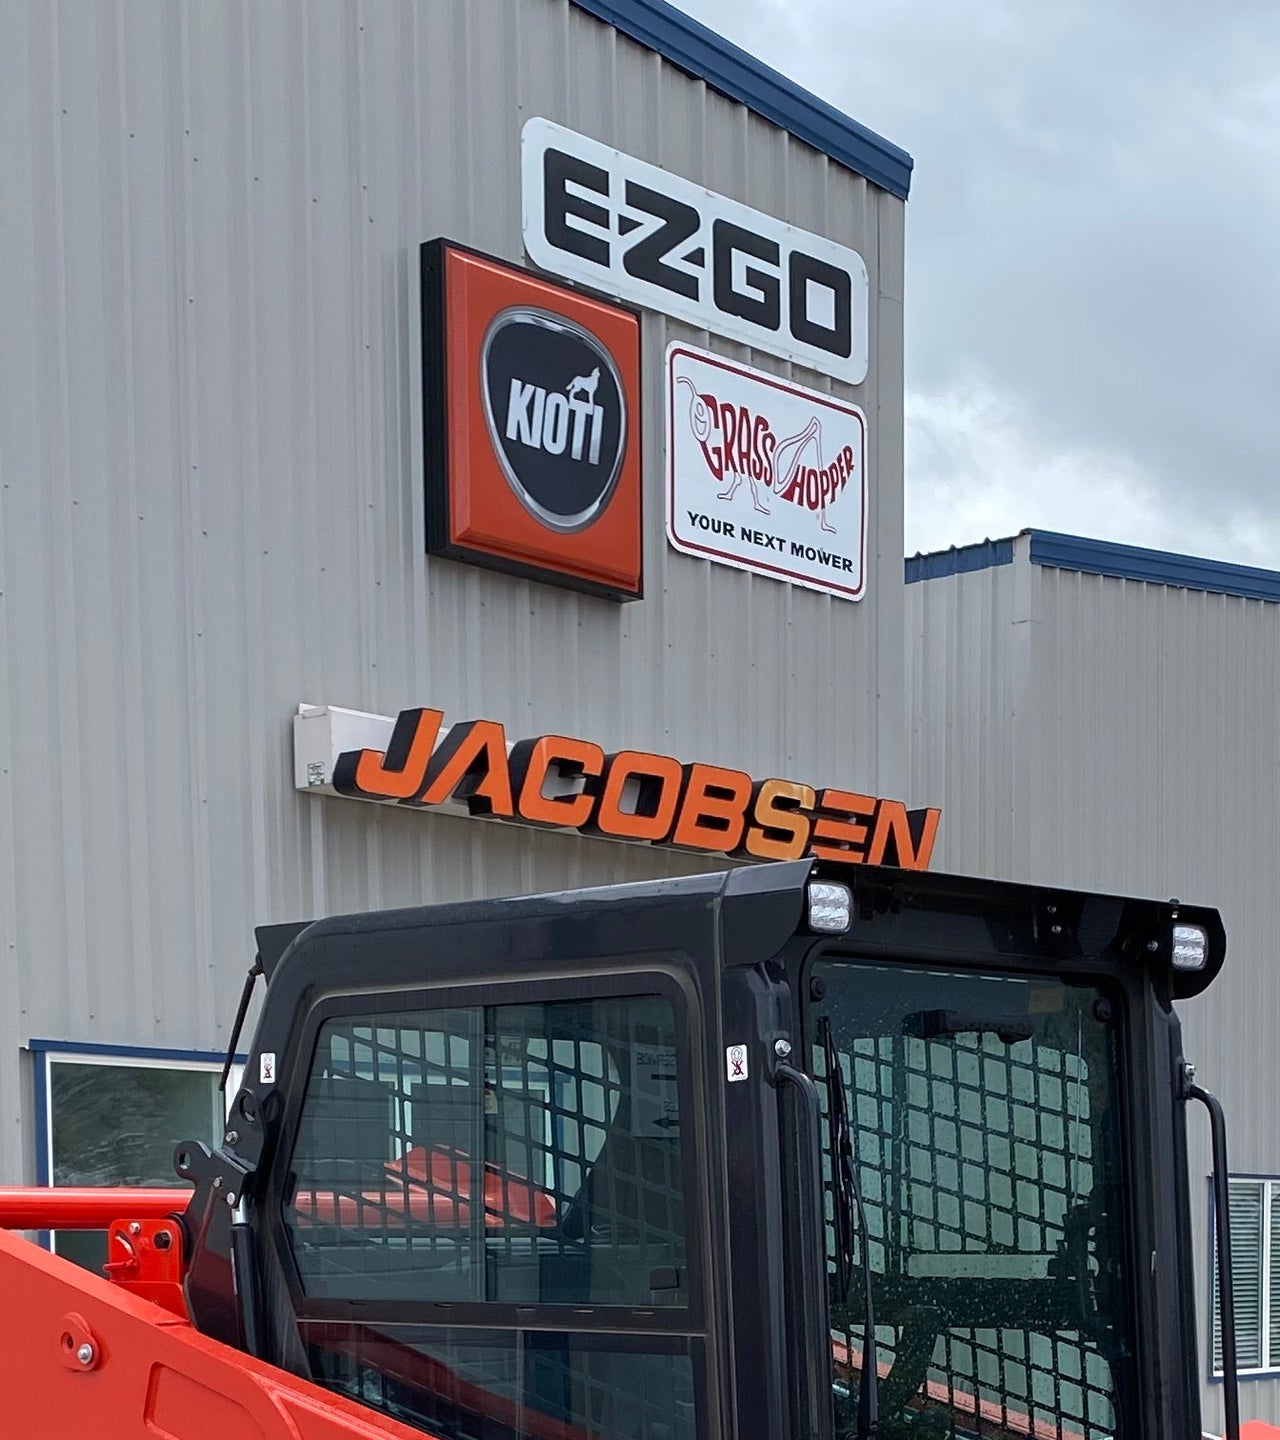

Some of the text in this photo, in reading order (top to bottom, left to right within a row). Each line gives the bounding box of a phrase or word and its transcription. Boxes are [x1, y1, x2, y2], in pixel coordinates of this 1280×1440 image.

[505, 378, 605, 466] KIOTI
[694, 393, 855, 511] GRASS HOPPER
[687, 510, 854, 574] YOUR NEXT MOWER
[338, 707, 943, 871] JACOBSEN
